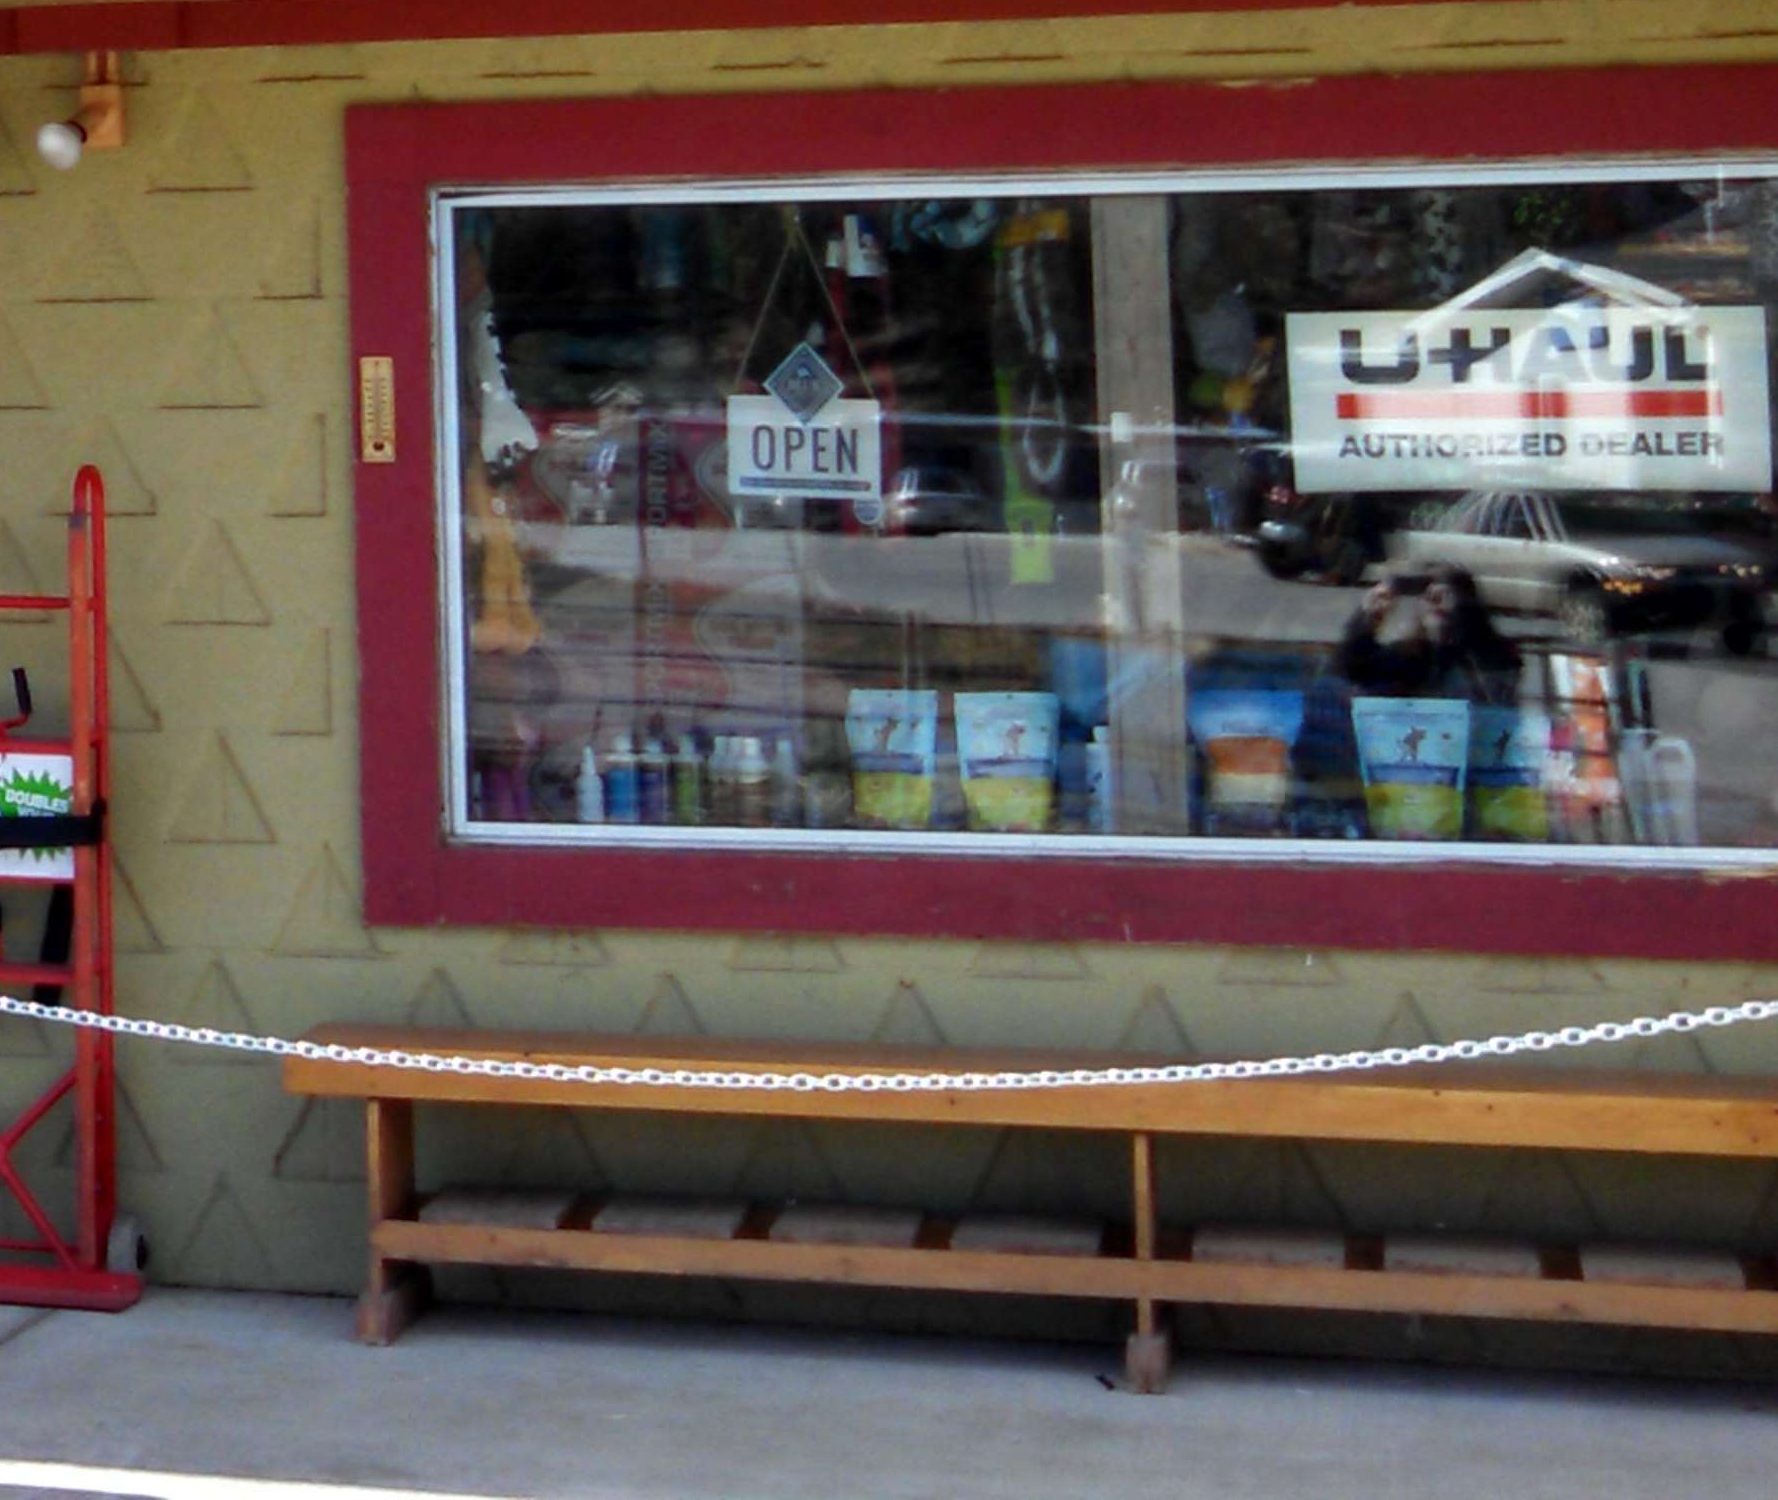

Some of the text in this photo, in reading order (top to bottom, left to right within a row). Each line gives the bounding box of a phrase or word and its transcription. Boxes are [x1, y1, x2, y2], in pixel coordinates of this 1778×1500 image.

[751, 423, 859, 475] OPEN
[1338, 430, 1726, 460] AUTHORIZED DEALER
